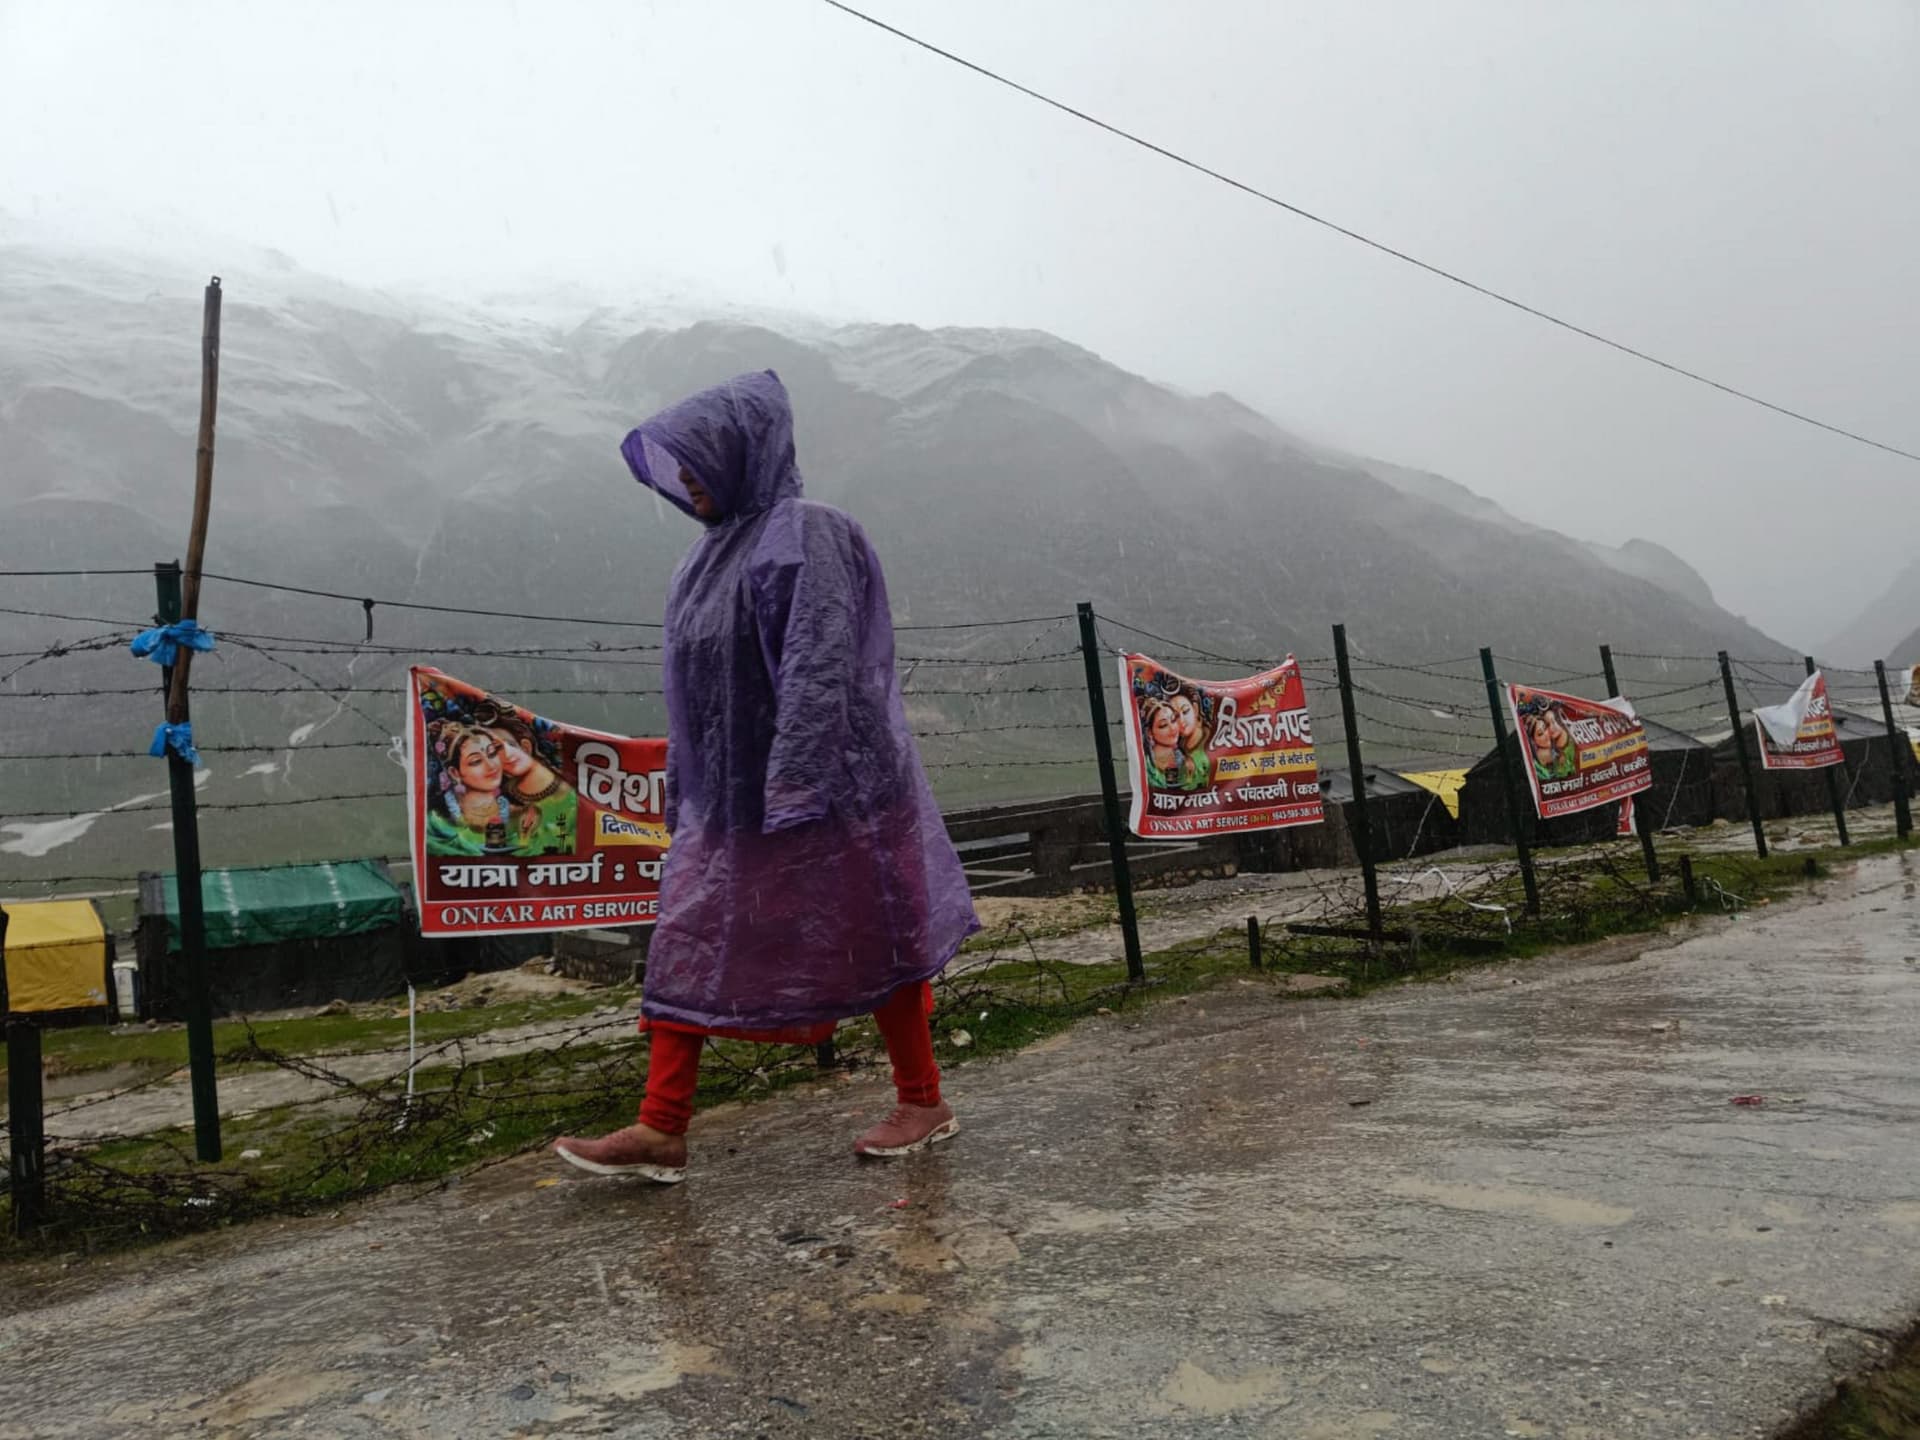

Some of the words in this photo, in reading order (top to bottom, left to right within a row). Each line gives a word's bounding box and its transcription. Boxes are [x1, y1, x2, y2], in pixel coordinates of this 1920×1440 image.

[1184, 785, 1220, 807] मार्ग
[1216, 815, 1249, 827] SERVICE
[439, 864, 520, 888] यात्रा
[527, 853, 604, 886] मार्ग
[440, 904, 536, 926] ONKAR
[541, 904, 577, 921] ART
[582, 900, 660, 918] SERVICE
